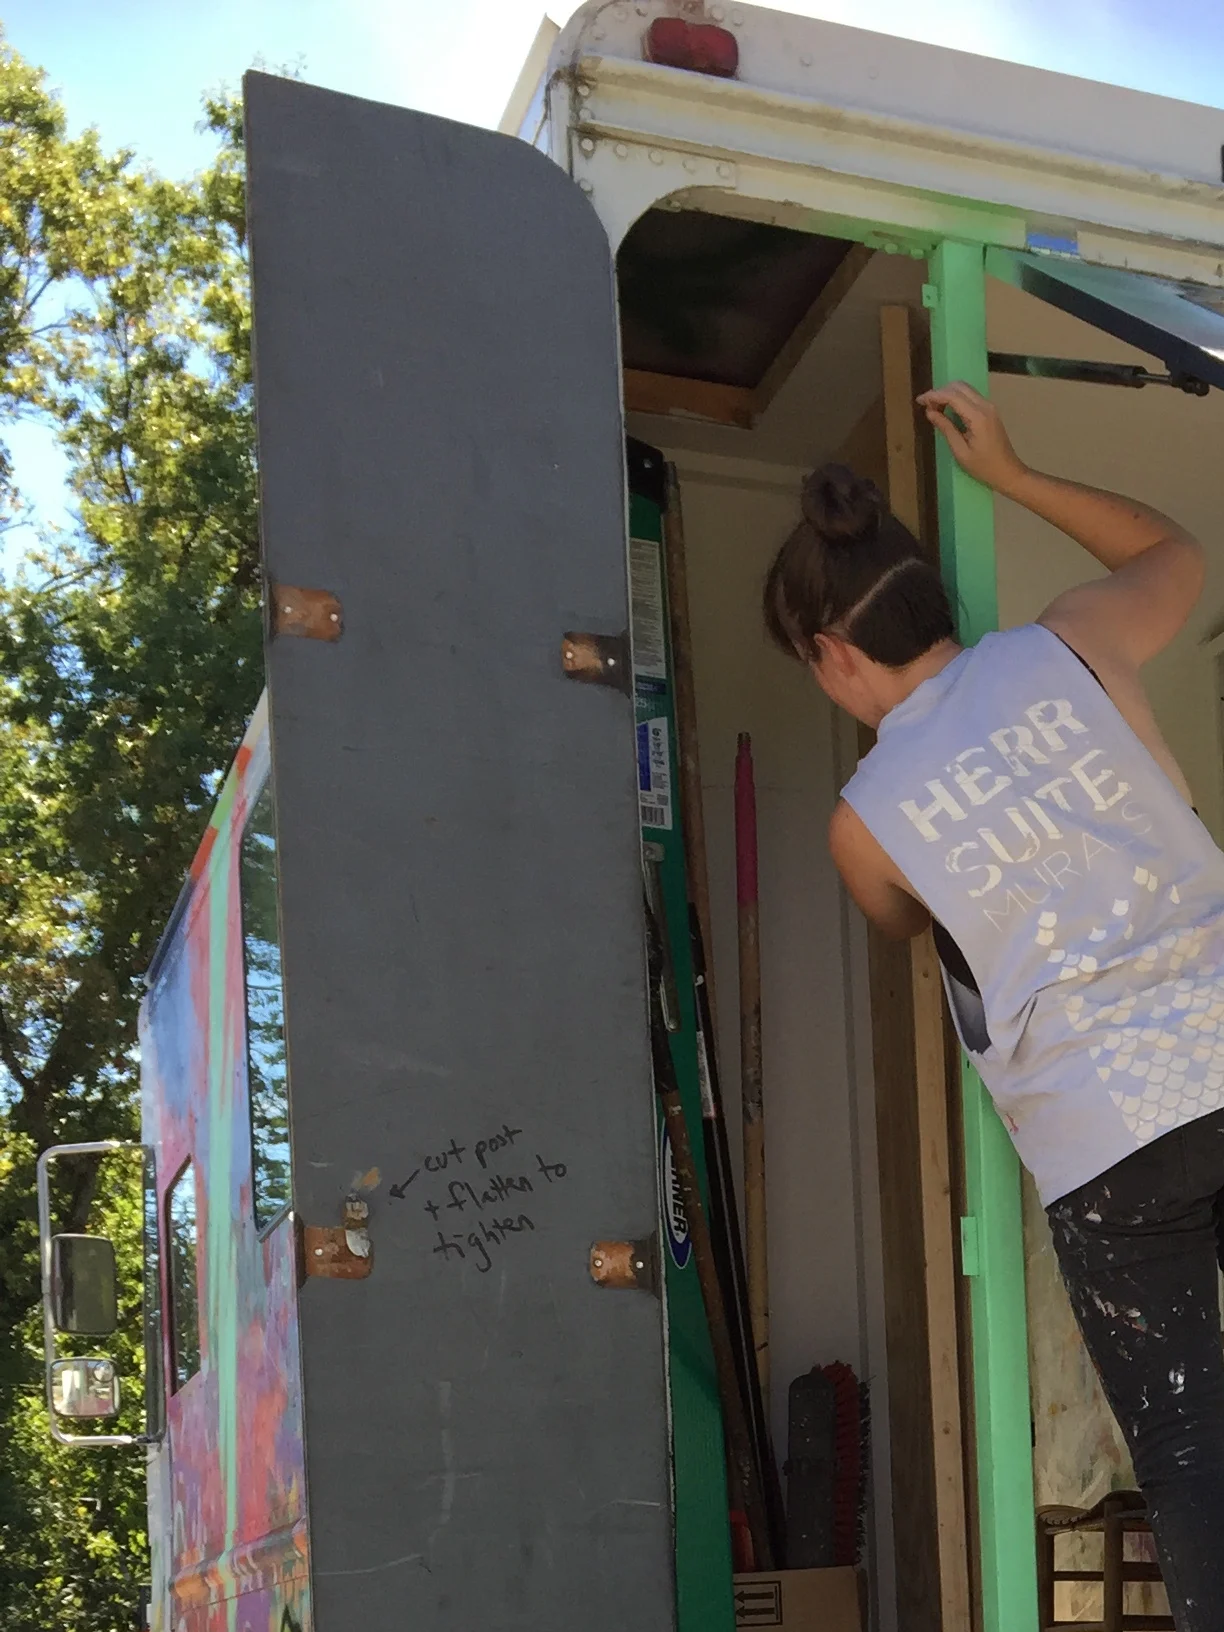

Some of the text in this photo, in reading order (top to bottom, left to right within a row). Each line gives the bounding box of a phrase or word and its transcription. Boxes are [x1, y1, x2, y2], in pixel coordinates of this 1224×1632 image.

[898, 697, 1090, 844] HERR
[943, 748, 1133, 899] SUITE
[423, 1124, 523, 1172] cut post
[446, 1173, 535, 1212] flatten
[536, 1153, 568, 1183] to
[432, 1212, 536, 1273] tighten
